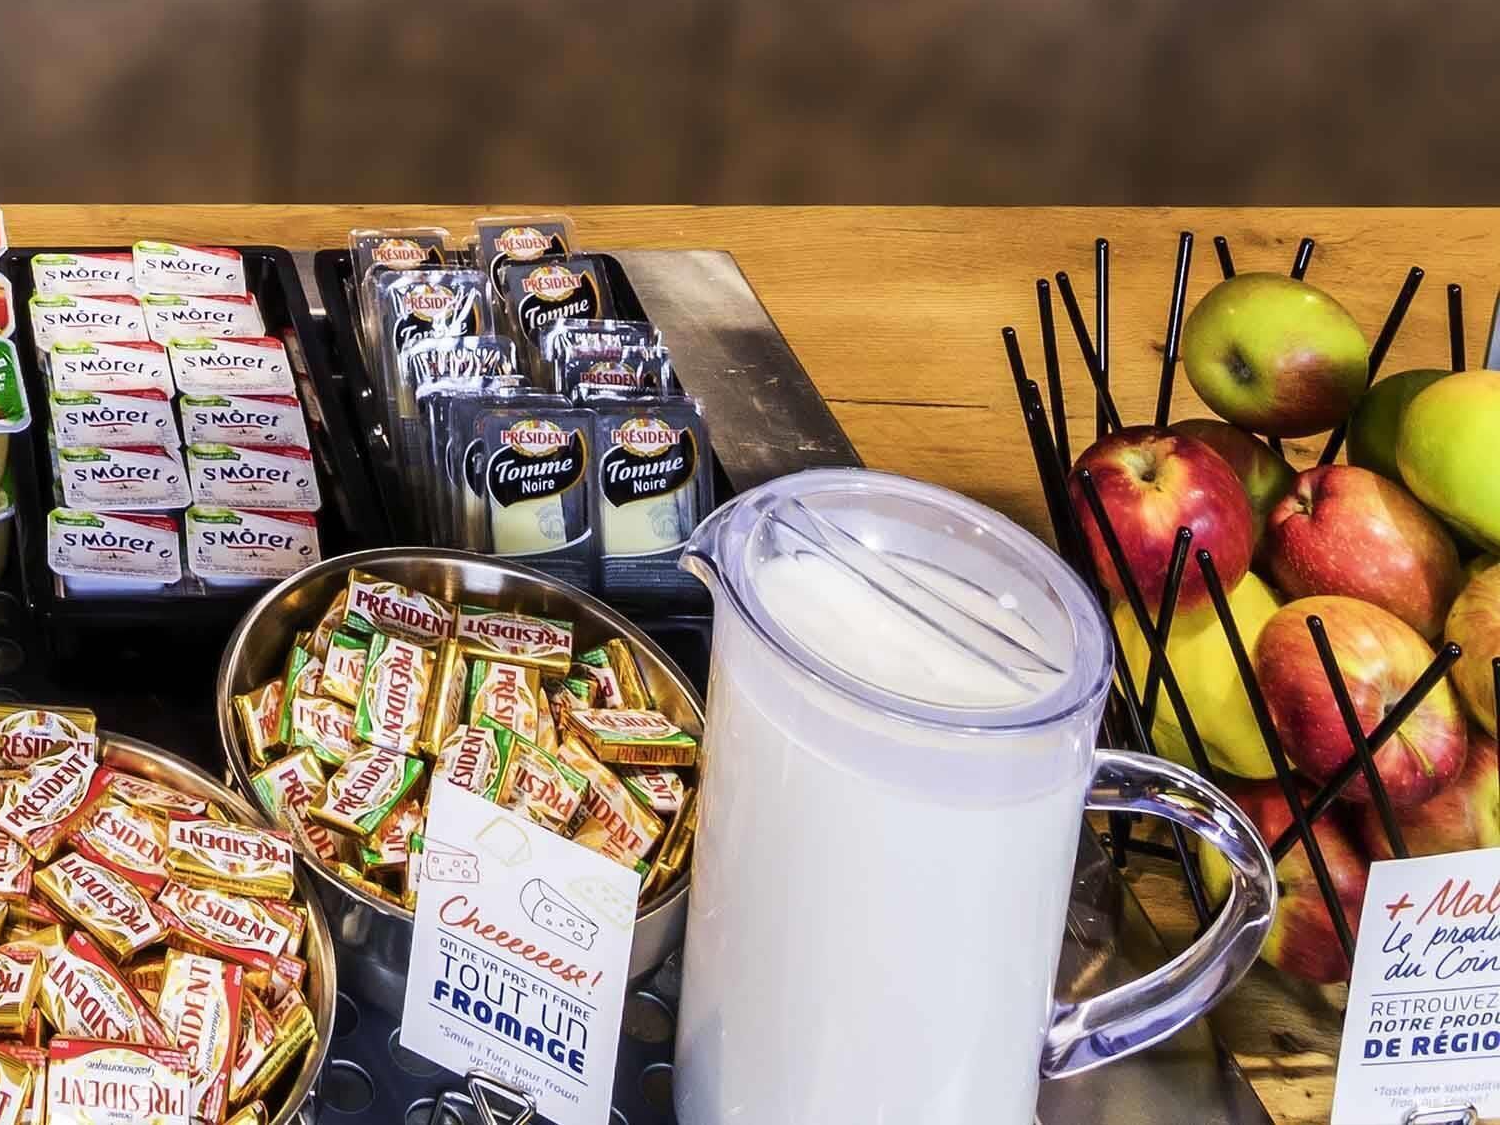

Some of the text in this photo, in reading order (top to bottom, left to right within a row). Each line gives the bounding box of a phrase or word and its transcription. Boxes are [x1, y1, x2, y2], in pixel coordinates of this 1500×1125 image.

[522, 274, 582, 290] PRÉSIDENT
[525, 299, 589, 329] Tomme
[501, 428, 571, 444] PRÉSIDENT
[611, 426, 681, 443] PRÉSIDENT
[495, 455, 573, 482] Tomme
[607, 454, 684, 481] Tomme
[522, 477, 555, 493] Noire
[633, 477, 666, 493] Noire
[356, 590, 453, 640] PRÉSIDENT
[465, 619, 570, 647] PRÉSIDENT
[383, 645, 413, 752] PRÉSIDENT
[5, 753, 88, 827] PRÉSIDENT
[60, 858, 150, 935] PRÉSIDENT
[164, 882, 279, 944] PRÉSIDENT
[1382, 921, 1412, 953] Le
[439, 938, 591, 1023] ON NE VA PAS EN FAIRE
[1384, 952, 1426, 981] du
[440, 951, 588, 1050] TOUT UN
[1371, 992, 1499, 1016] RETROUVEZ
[433, 980, 585, 1075] FROMAGE
[1369, 1017, 1434, 1033] NOTRE
[1364, 1029, 1500, 1059] DE RÉGIO
[486, 1048, 511, 1068] Turn
[514, 1064, 540, 1082] your
[59, 1077, 185, 1116] PRÉSIDENT
